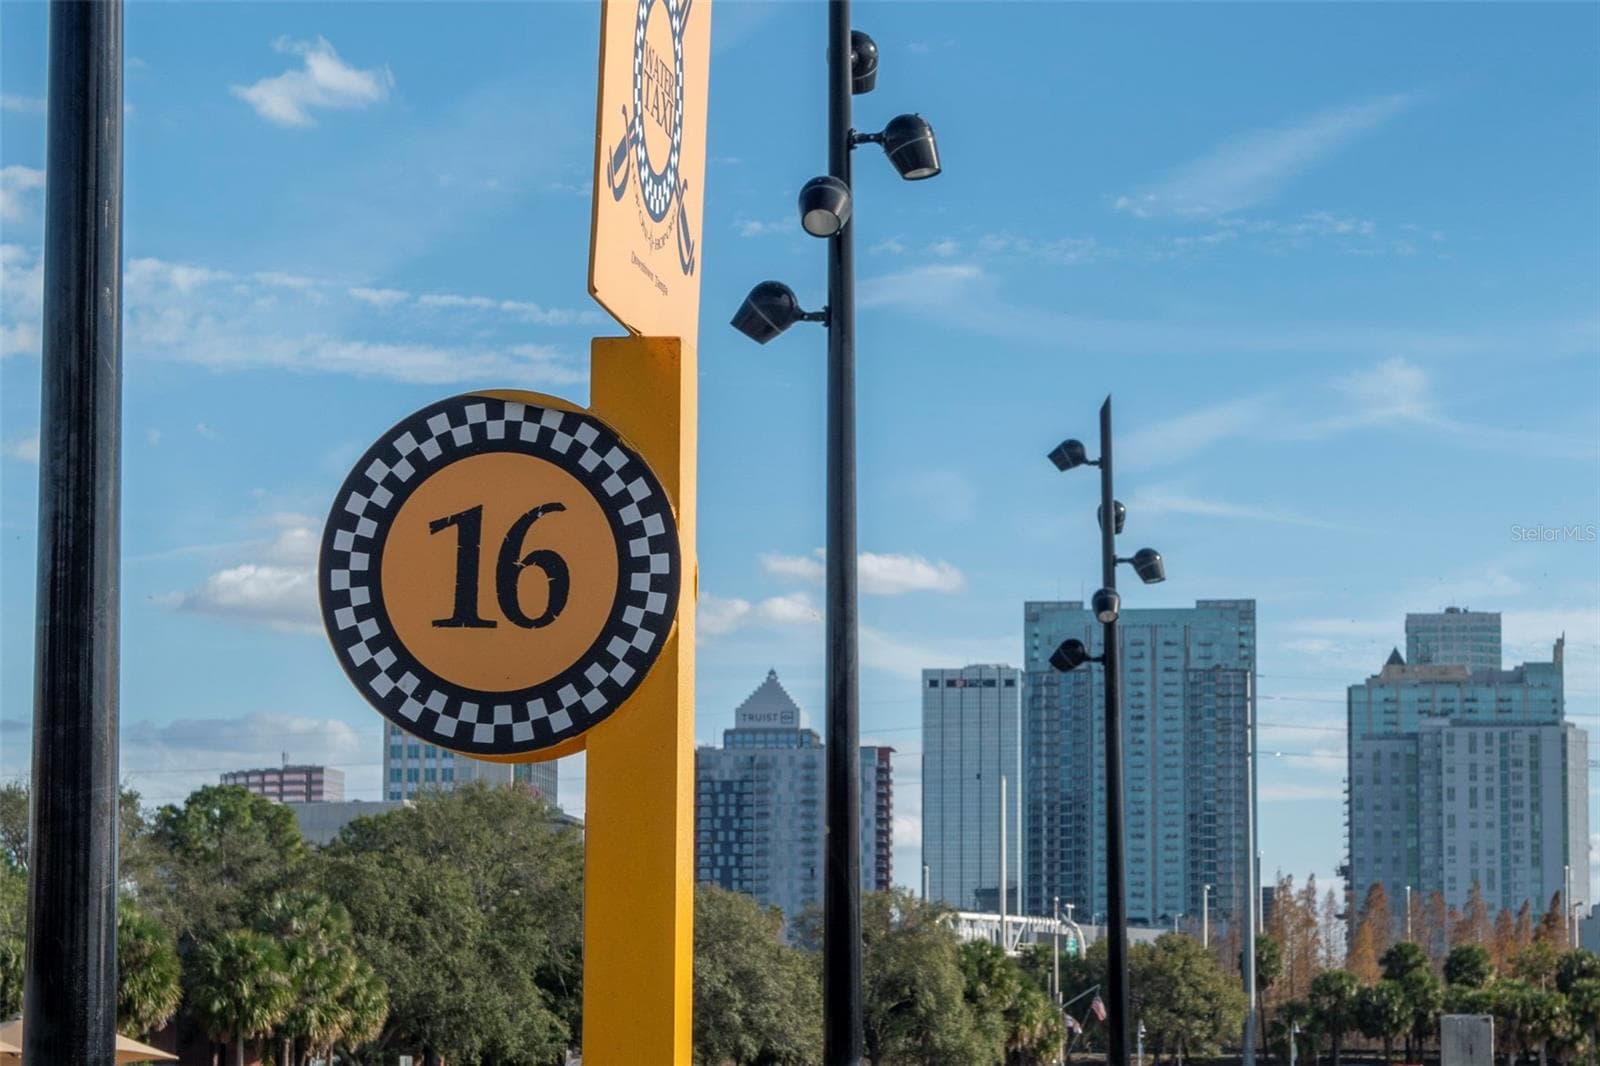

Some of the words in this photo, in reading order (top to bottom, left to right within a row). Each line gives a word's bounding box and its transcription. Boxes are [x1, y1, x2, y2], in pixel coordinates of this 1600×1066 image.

[644, 68, 674, 141] TAXI
[646, 40, 674, 102] WATER
[429, 502, 570, 629] 16
[742, 712, 779, 723] TRUIST
